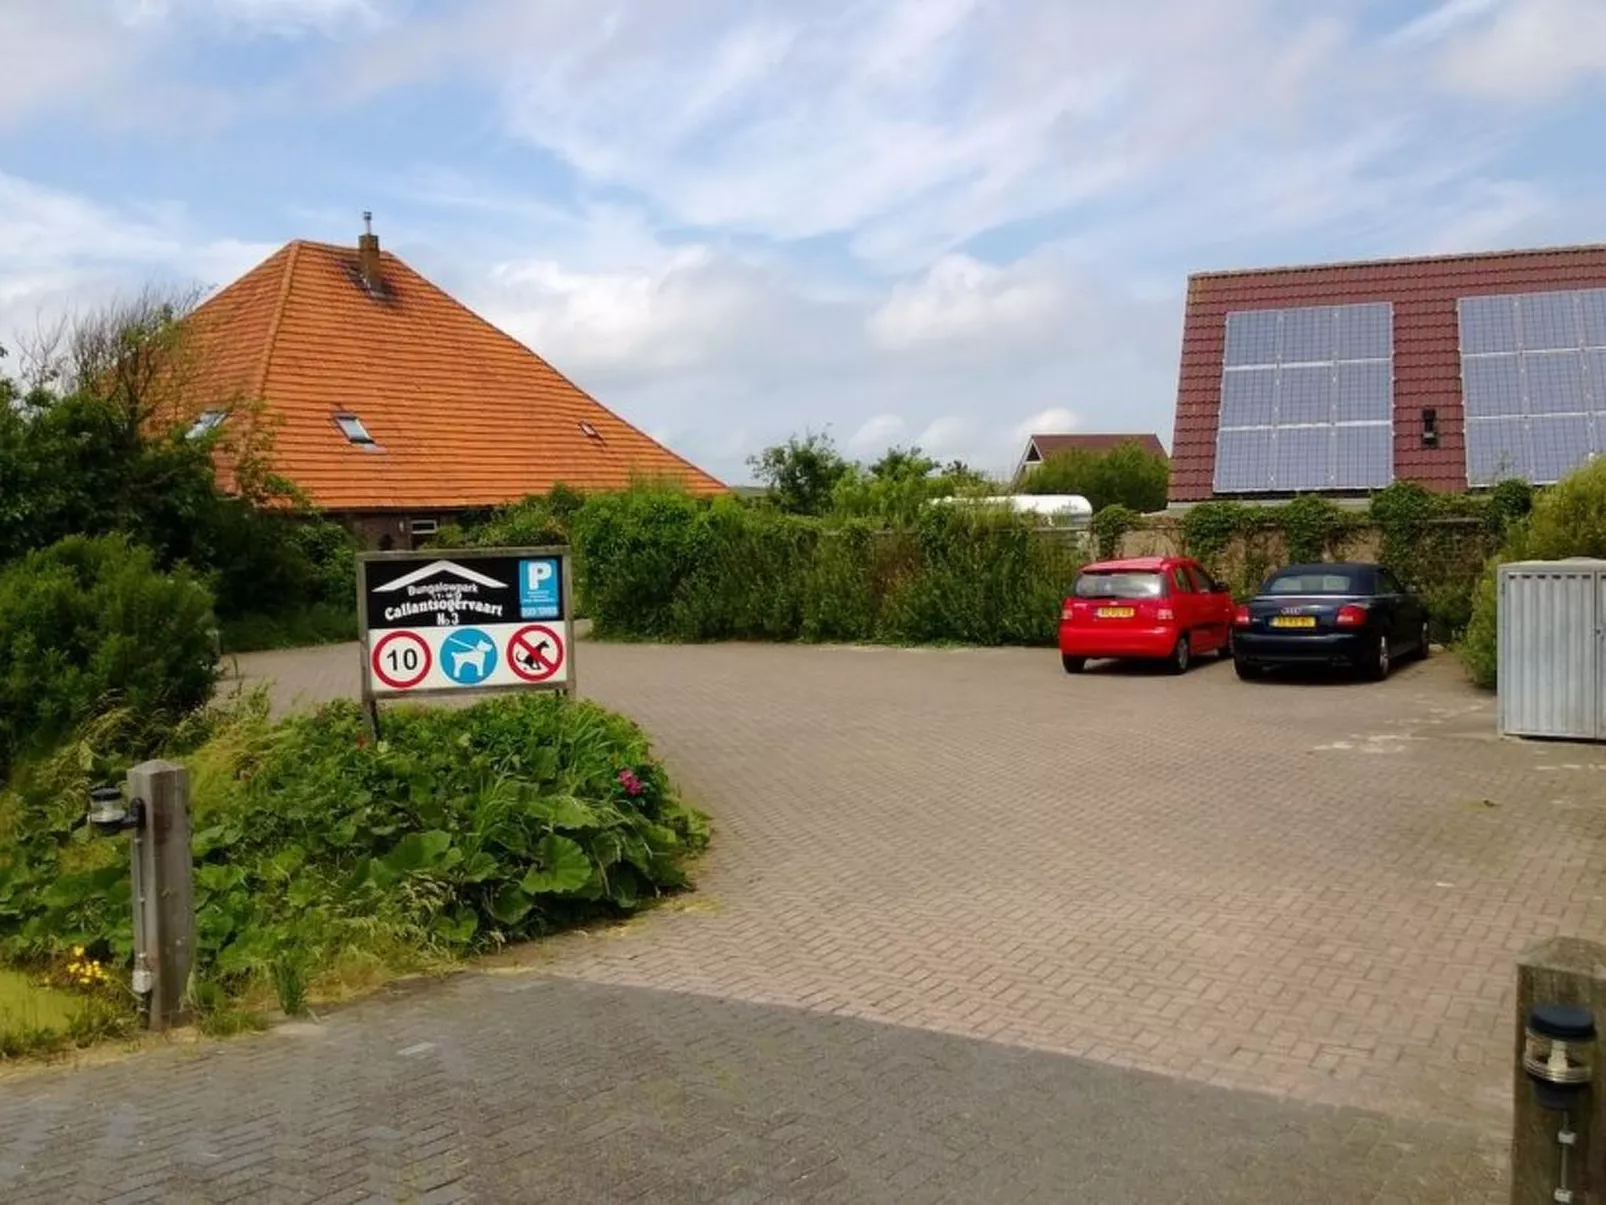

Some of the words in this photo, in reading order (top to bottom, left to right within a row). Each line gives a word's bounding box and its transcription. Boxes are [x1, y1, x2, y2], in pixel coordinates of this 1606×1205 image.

[527, 562, 551, 590] P
[408, 582, 478, 596] Bungalowpark
[384, 599, 503, 621] Callantsogervaart
[387, 648, 418, 671] 10
